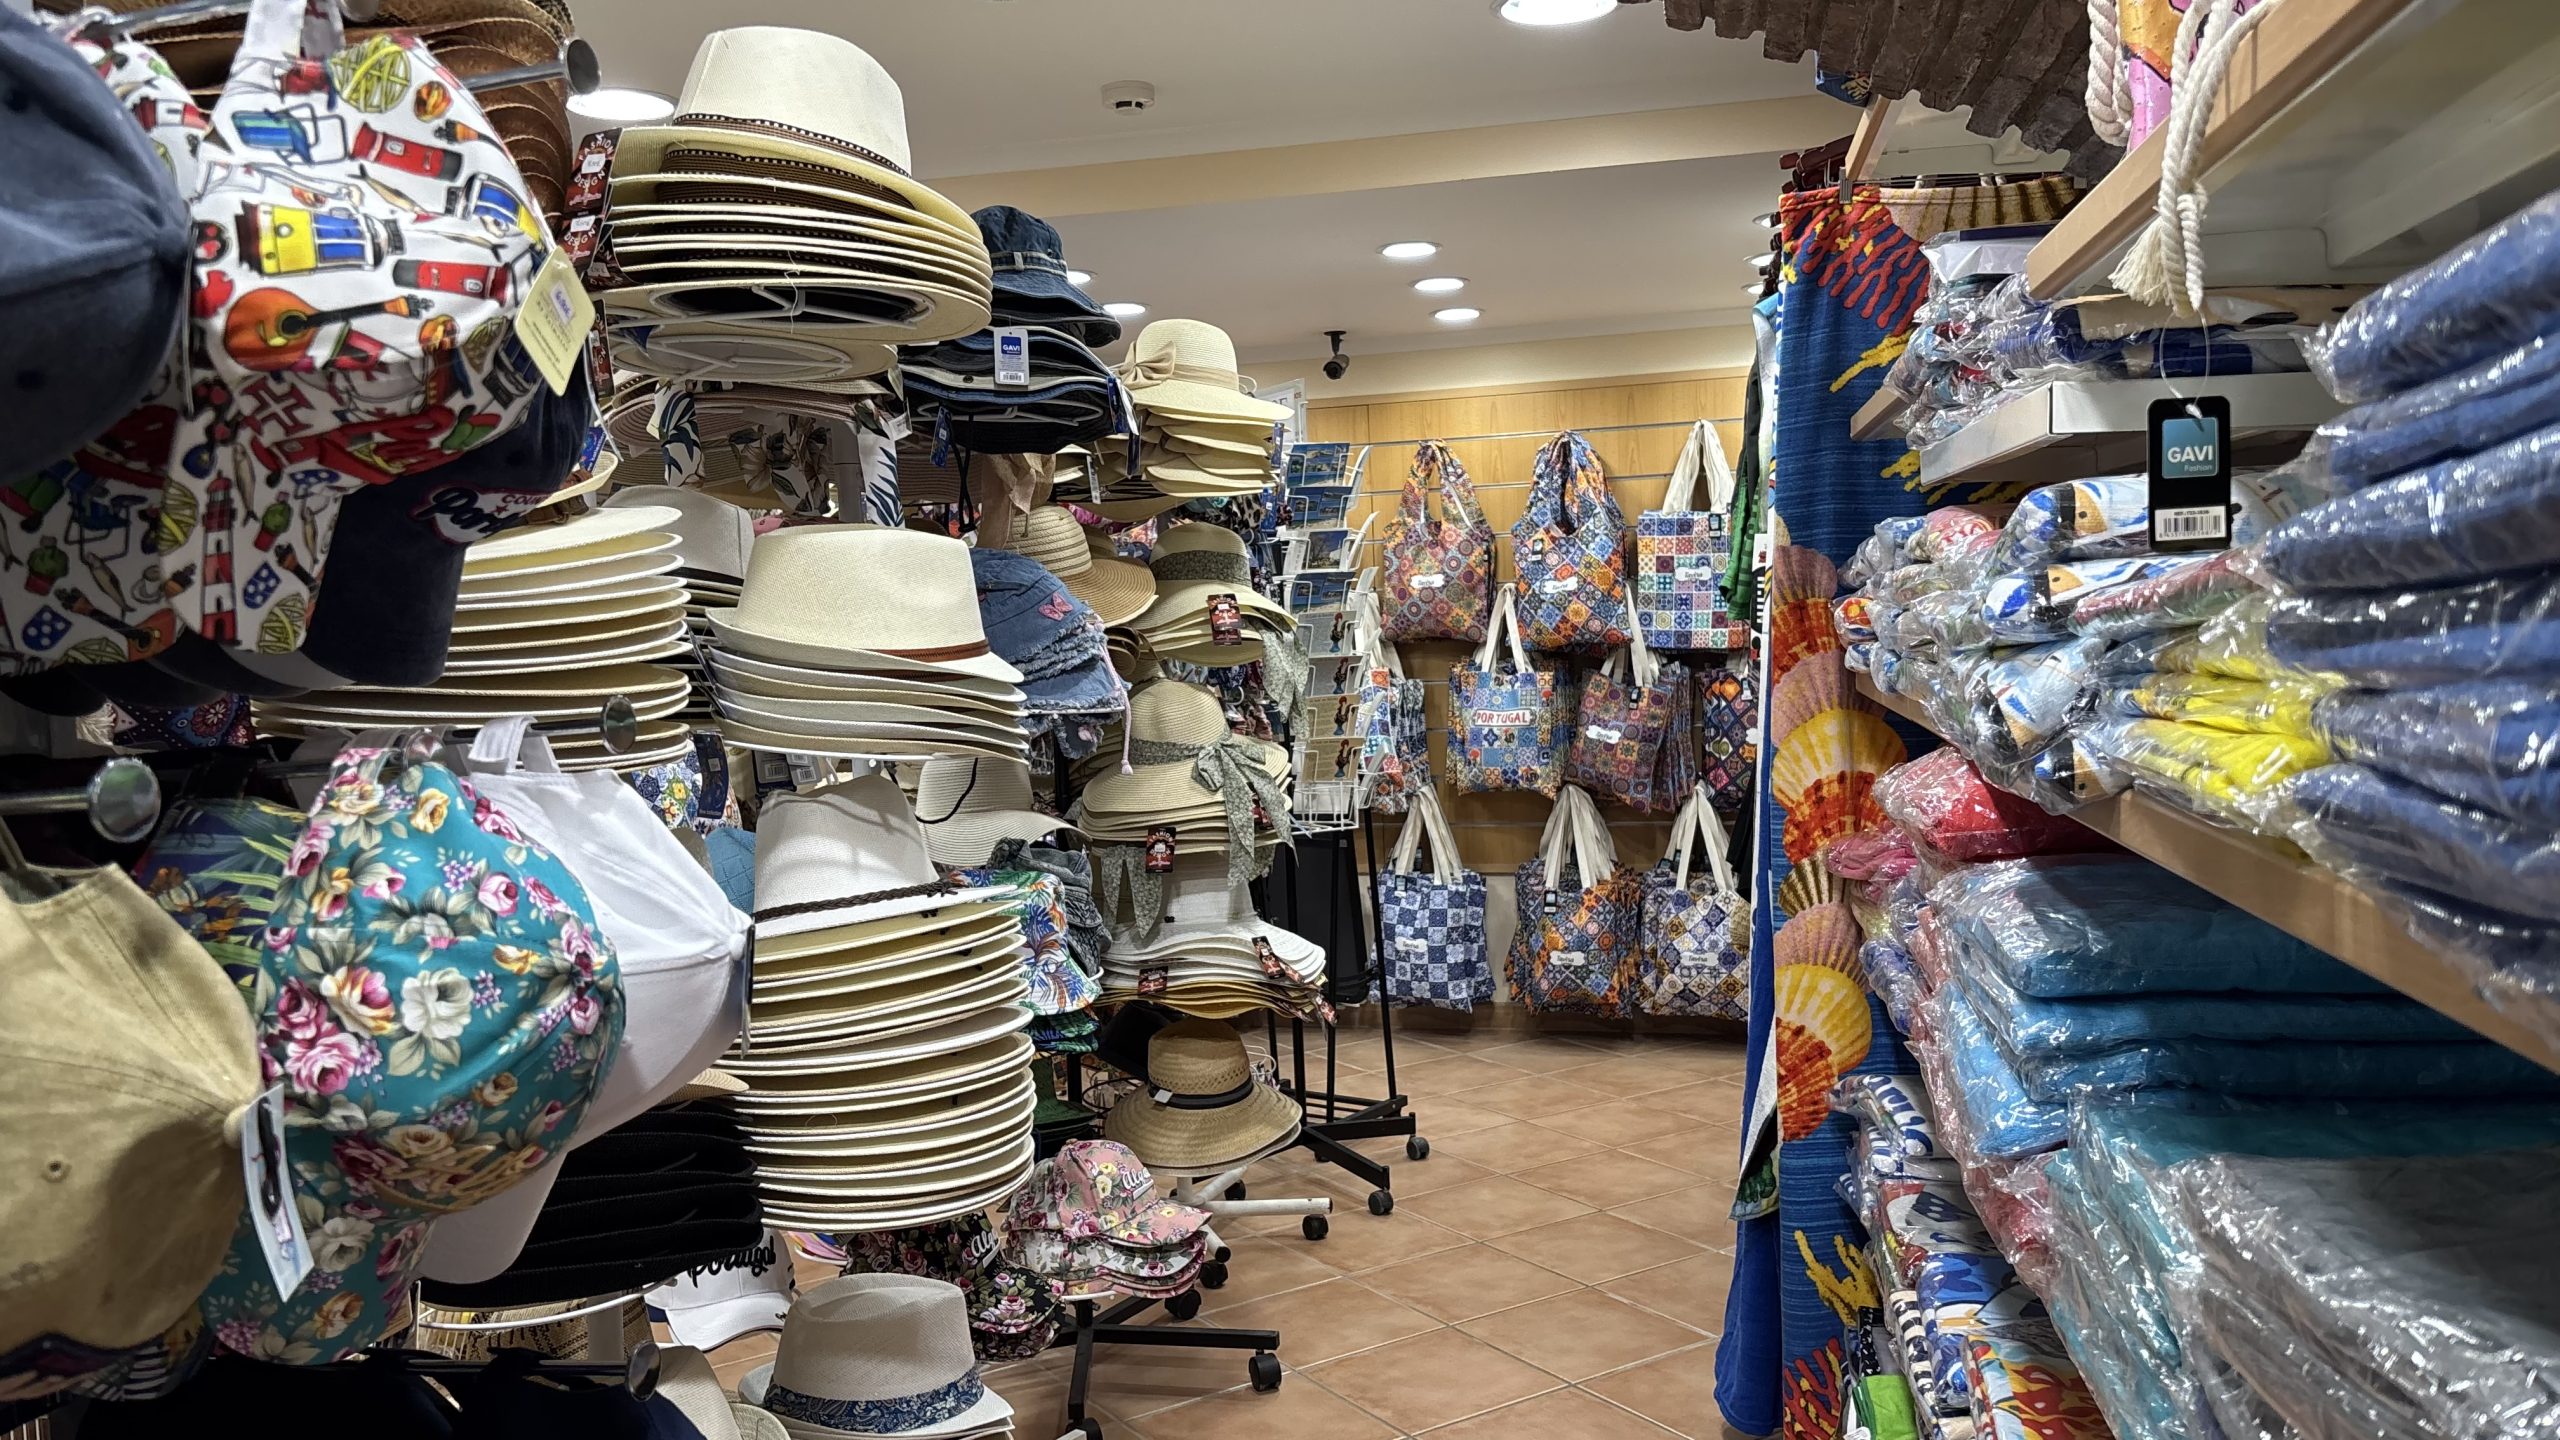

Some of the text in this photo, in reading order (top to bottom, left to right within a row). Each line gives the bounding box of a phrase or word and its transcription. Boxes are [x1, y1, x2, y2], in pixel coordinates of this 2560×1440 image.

[1002, 344, 1020, 352] GAVI
[2167, 445, 2214, 463] GAVI
[2184, 464, 2213, 472] Fashion
[1476, 712, 1528, 723] PORTUGAL
